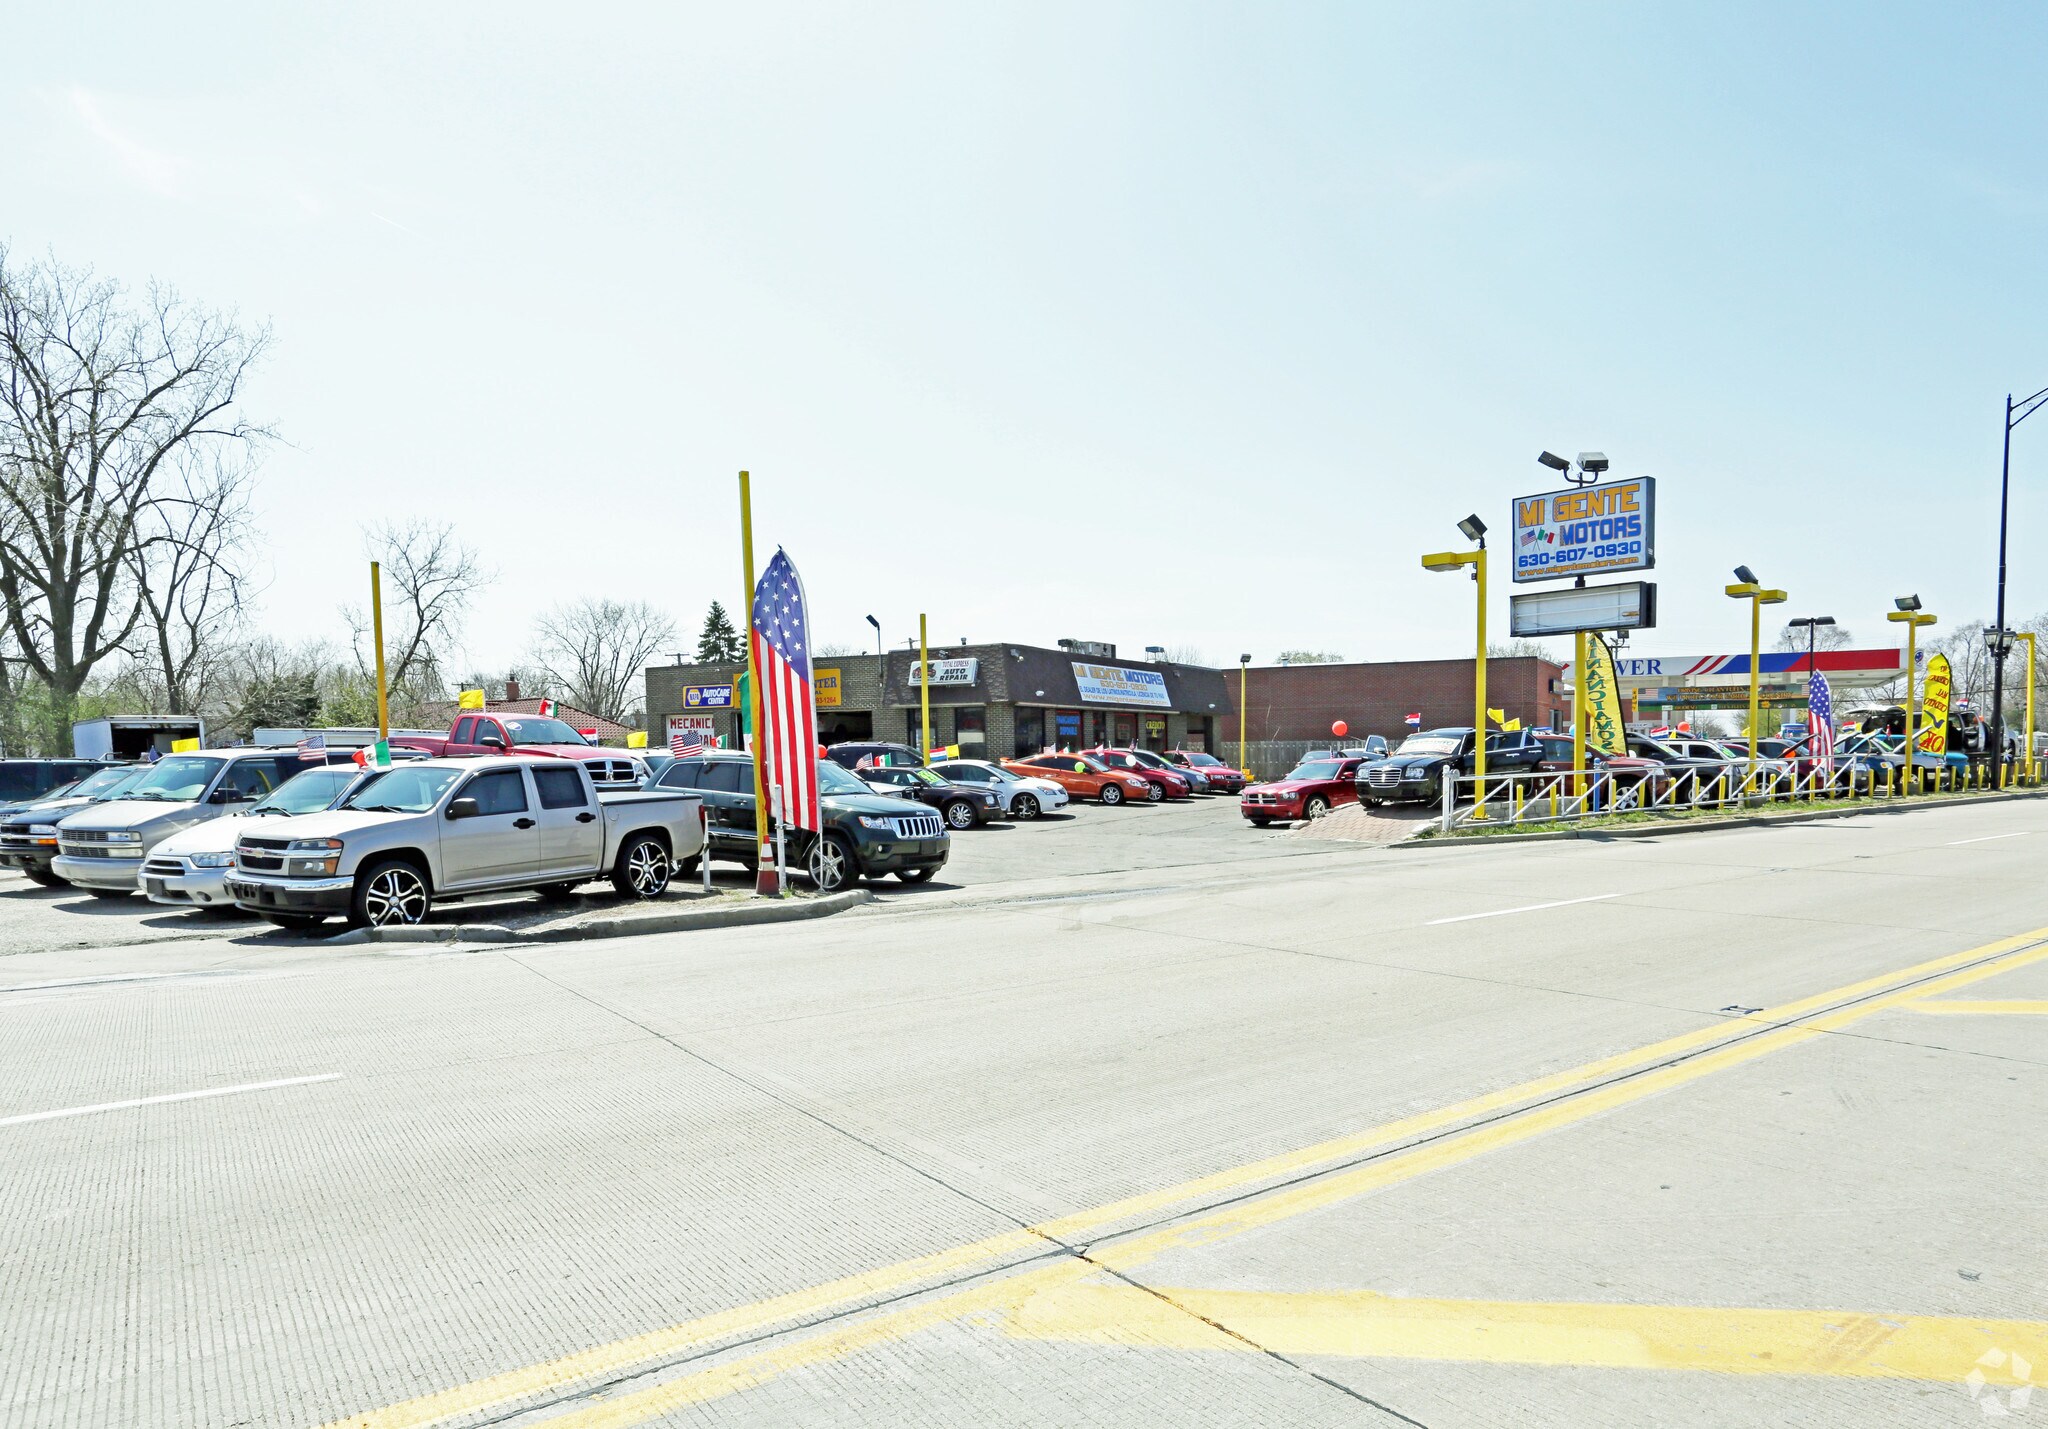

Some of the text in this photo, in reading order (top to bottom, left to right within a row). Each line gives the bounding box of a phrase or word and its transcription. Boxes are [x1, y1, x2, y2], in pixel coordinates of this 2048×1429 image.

[1519, 483, 1640, 528] MI GENTE
[1559, 515, 1641, 546] MOTORS
[1518, 541, 1641, 567] 630-607-0930
[1518, 557, 1639, 577] www.migentemotors.com
[1123, 670, 1163, 685] MOTORS
[707, 697, 725, 705] CENTER
